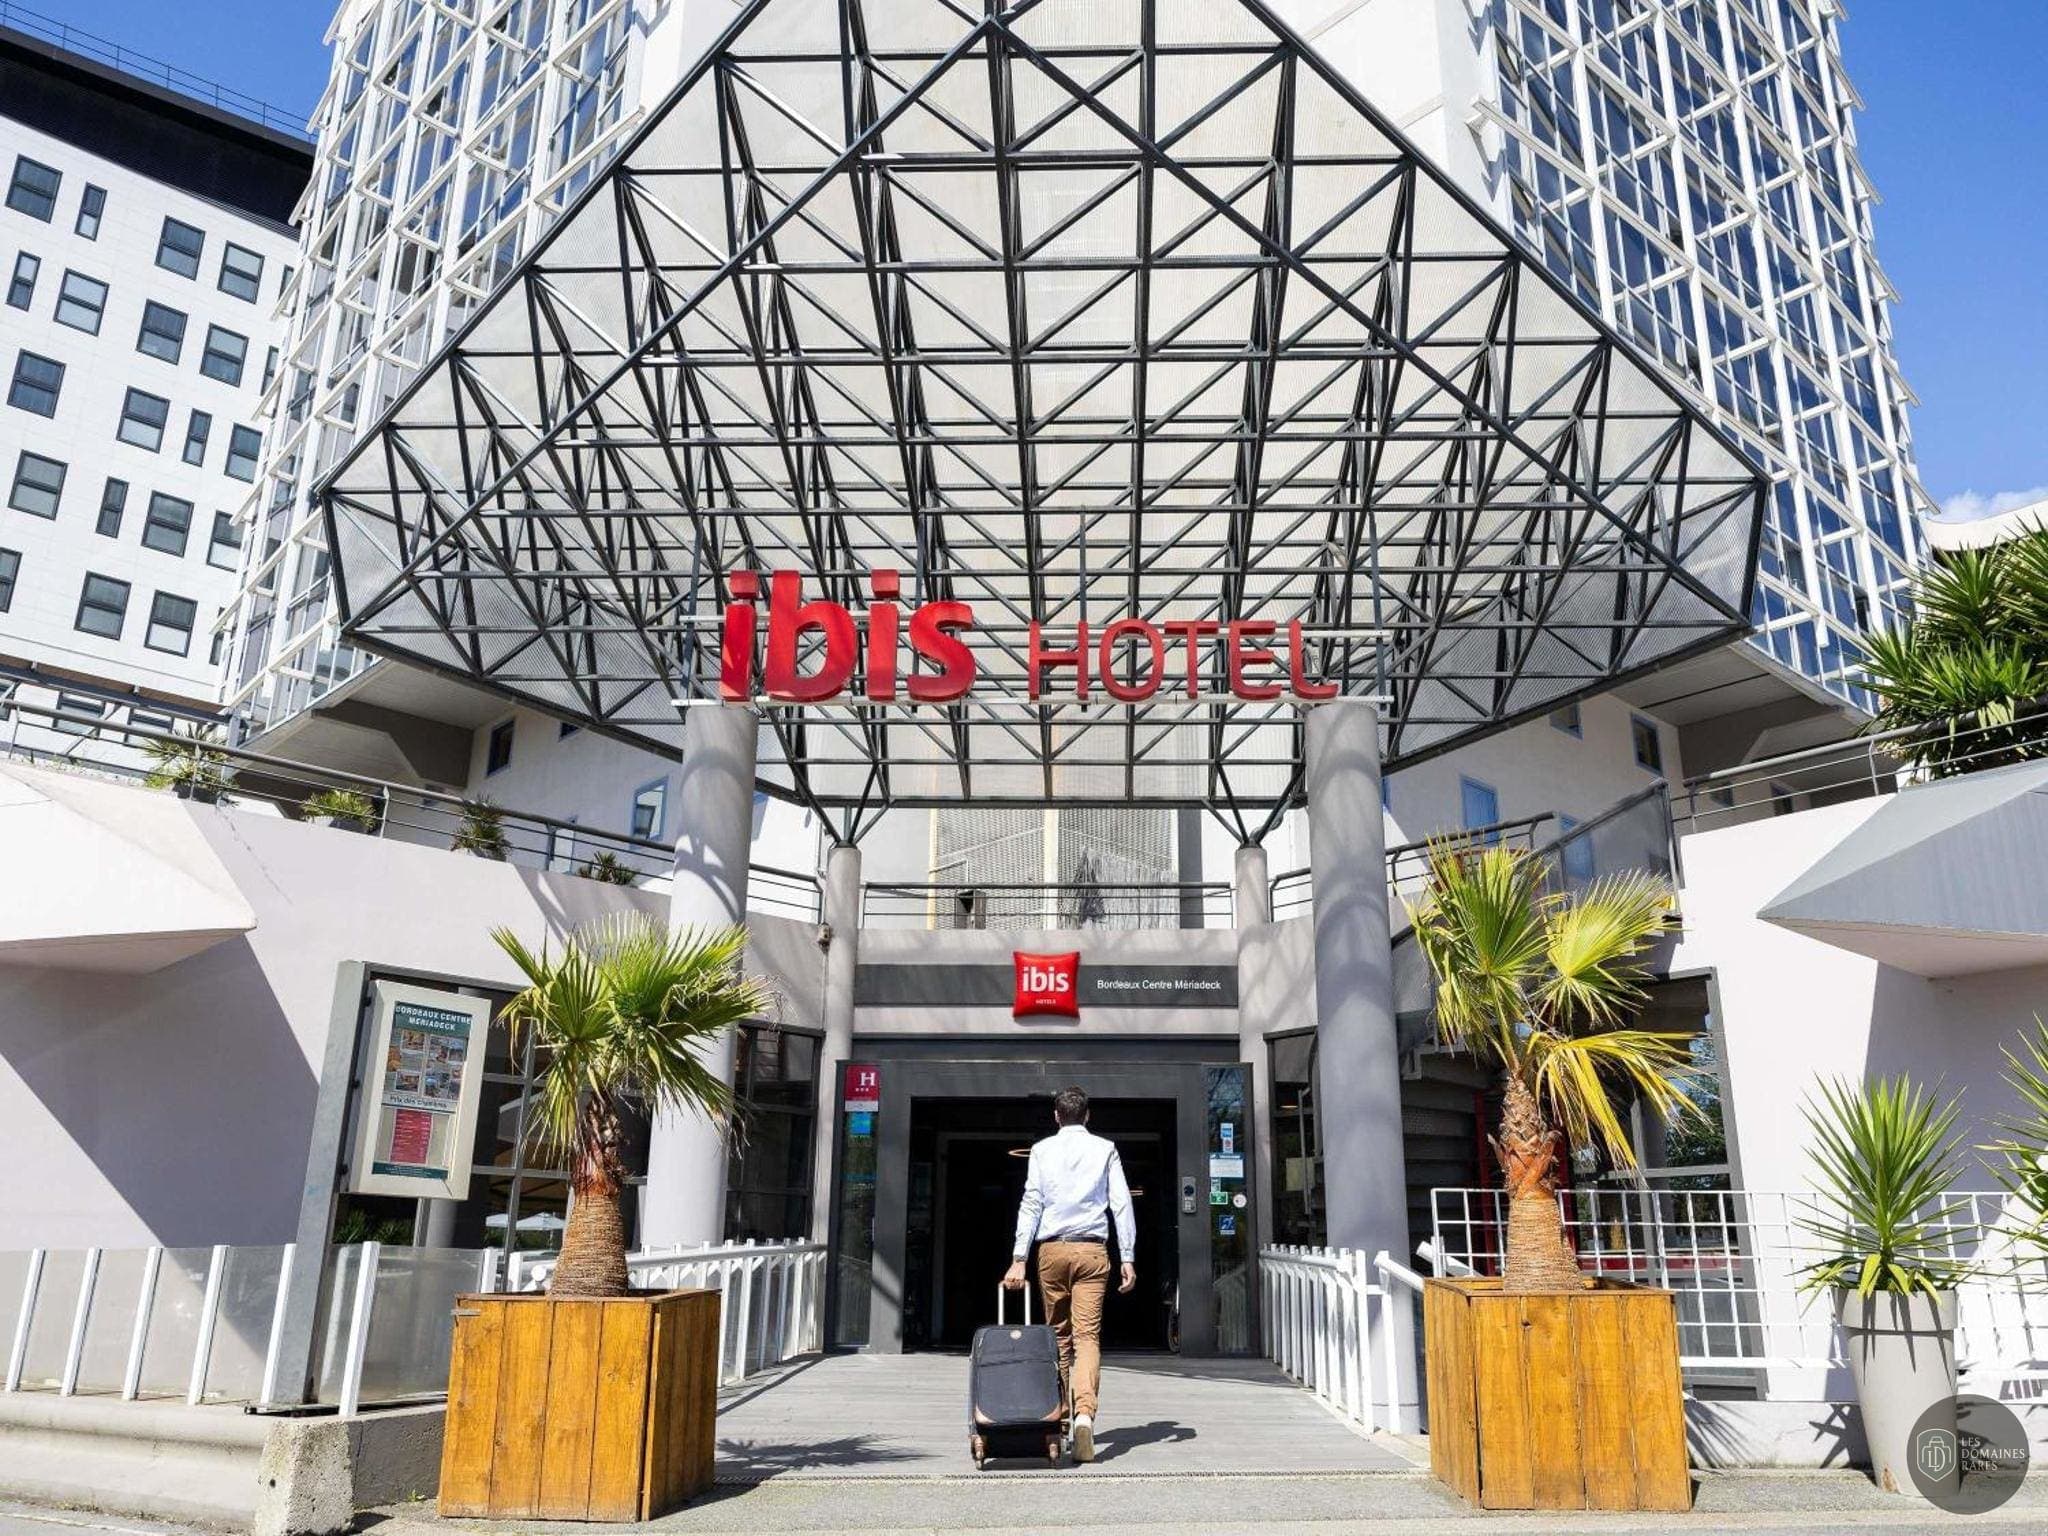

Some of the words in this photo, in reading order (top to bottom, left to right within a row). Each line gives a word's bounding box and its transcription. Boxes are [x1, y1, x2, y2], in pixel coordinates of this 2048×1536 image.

[721, 569, 976, 702] ibis
[1028, 618, 1339, 702] HOTEL
[1023, 966, 1069, 992] ibis
[1097, 979, 1140, 990] Bordeaux
[1142, 979, 1173, 990] Centre
[440, 1013, 471, 1025] CENTRE
[860, 1072, 876, 1086] H
